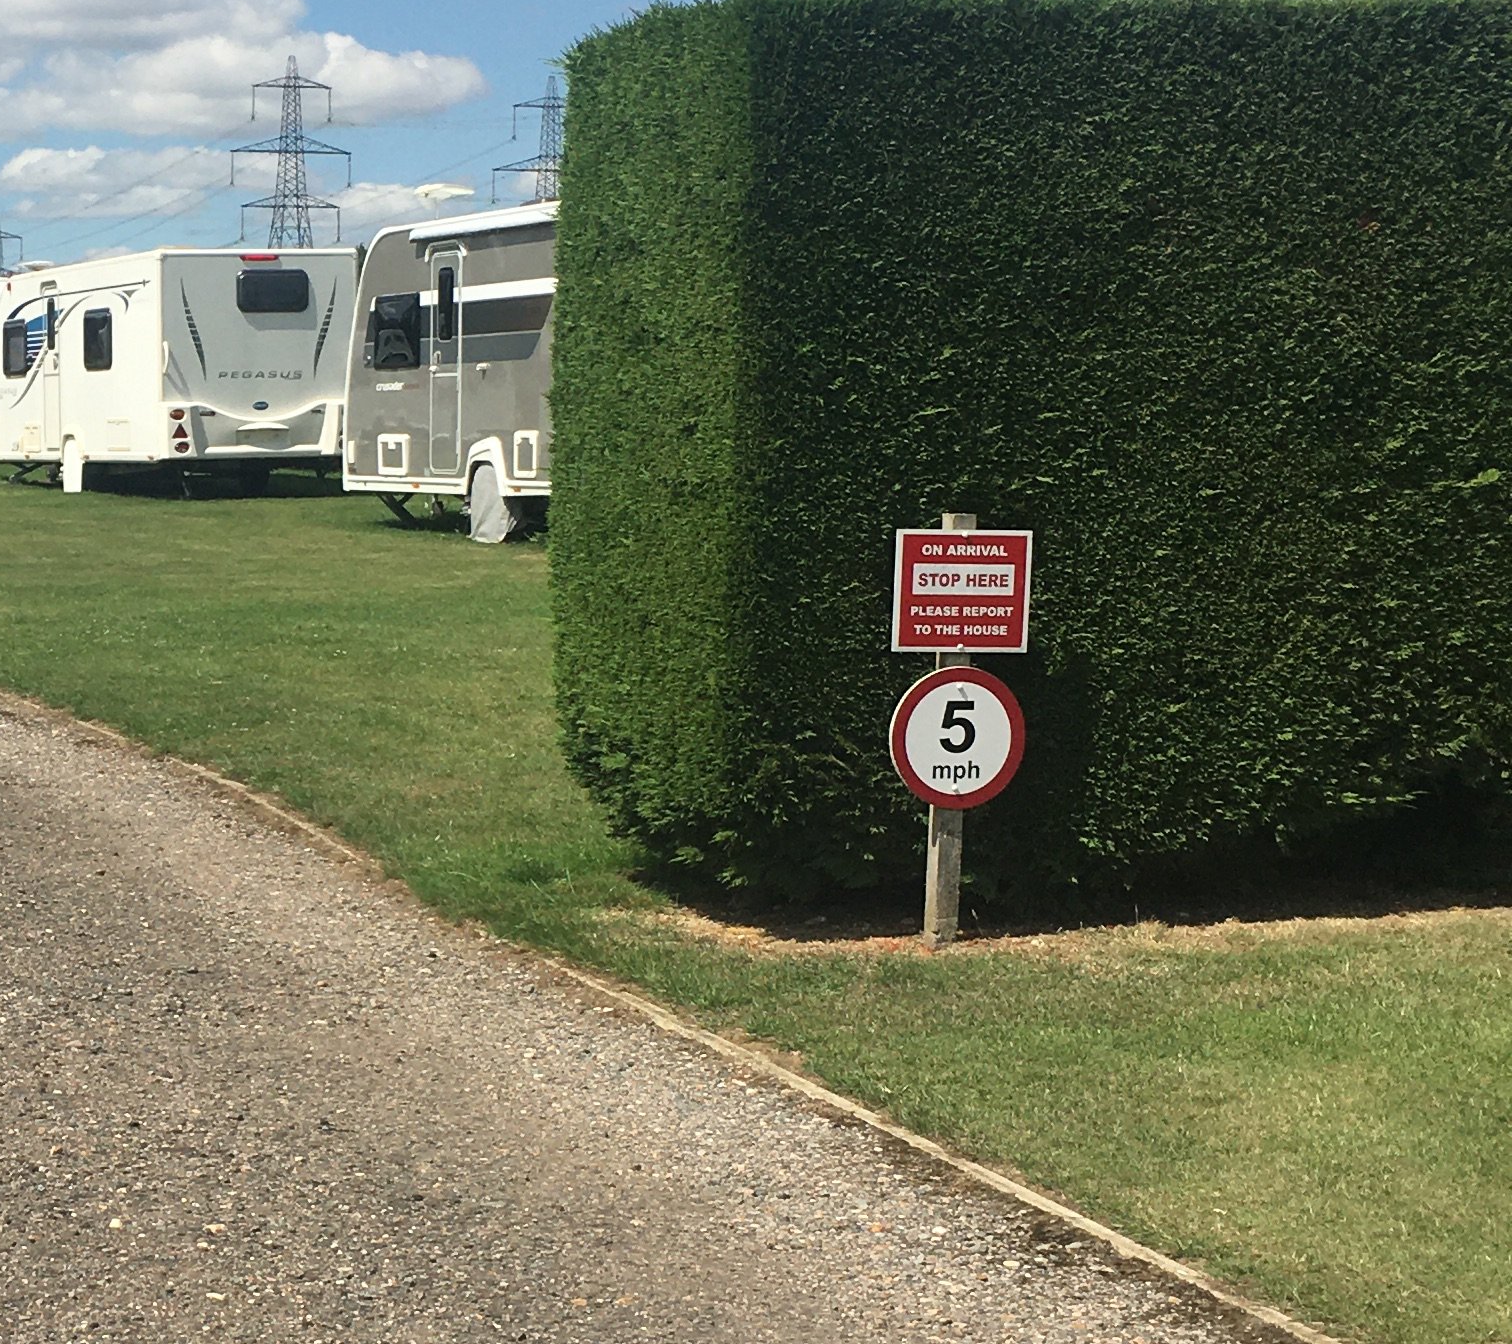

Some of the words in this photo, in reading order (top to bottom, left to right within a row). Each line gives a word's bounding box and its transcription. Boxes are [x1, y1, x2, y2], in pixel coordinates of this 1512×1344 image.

[218, 371, 303, 380] PEGASUS
[922, 544, 943, 556] ON
[946, 545, 1008, 557] ARRIVAL
[918, 573, 961, 587] STOP
[966, 574, 1009, 587] HERE
[910, 606, 959, 617] PLEASE
[963, 606, 1014, 618] REPORT
[914, 624, 931, 635] TO
[936, 625, 960, 635] THE
[963, 625, 1008, 636] HOUSE
[939, 700, 976, 753] 5
[932, 761, 980, 783] mph
